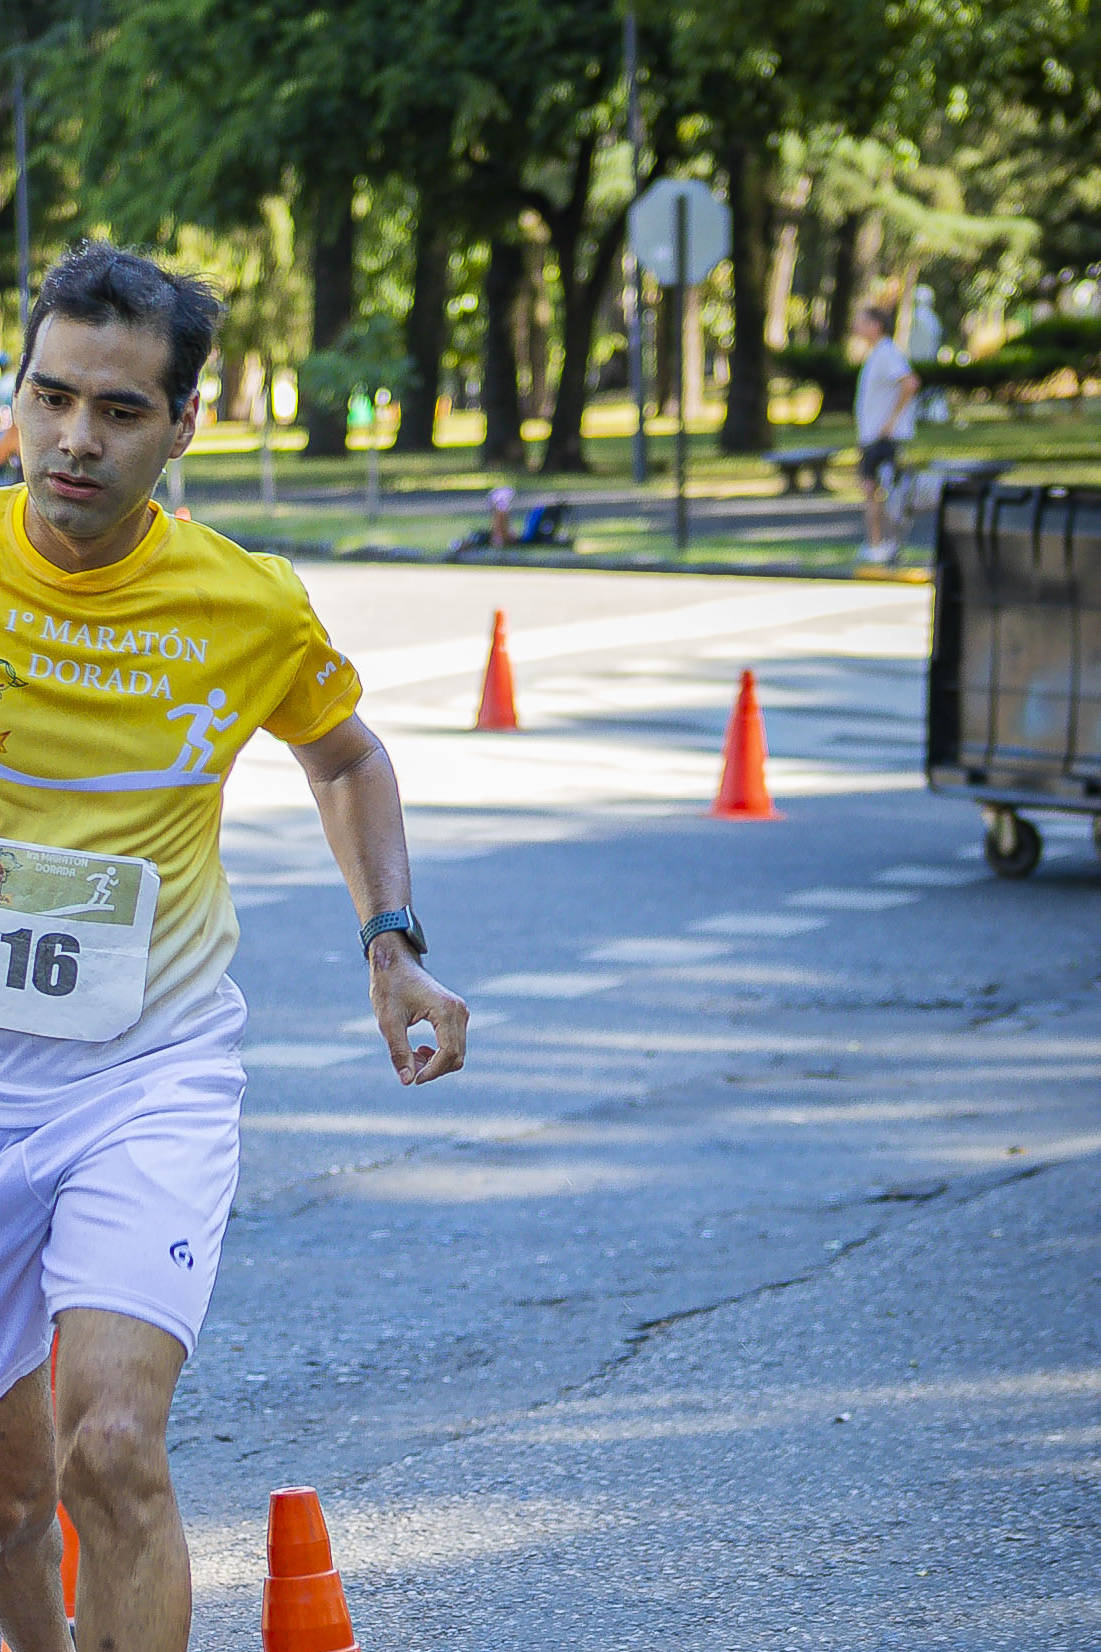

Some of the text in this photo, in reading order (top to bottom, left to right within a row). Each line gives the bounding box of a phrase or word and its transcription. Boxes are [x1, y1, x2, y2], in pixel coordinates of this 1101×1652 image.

[39, 614, 209, 664] MARATÓN
[27, 652, 174, 700] DORADA
[34, 862, 77, 877] DORADA
[0, 927, 81, 997] 16
